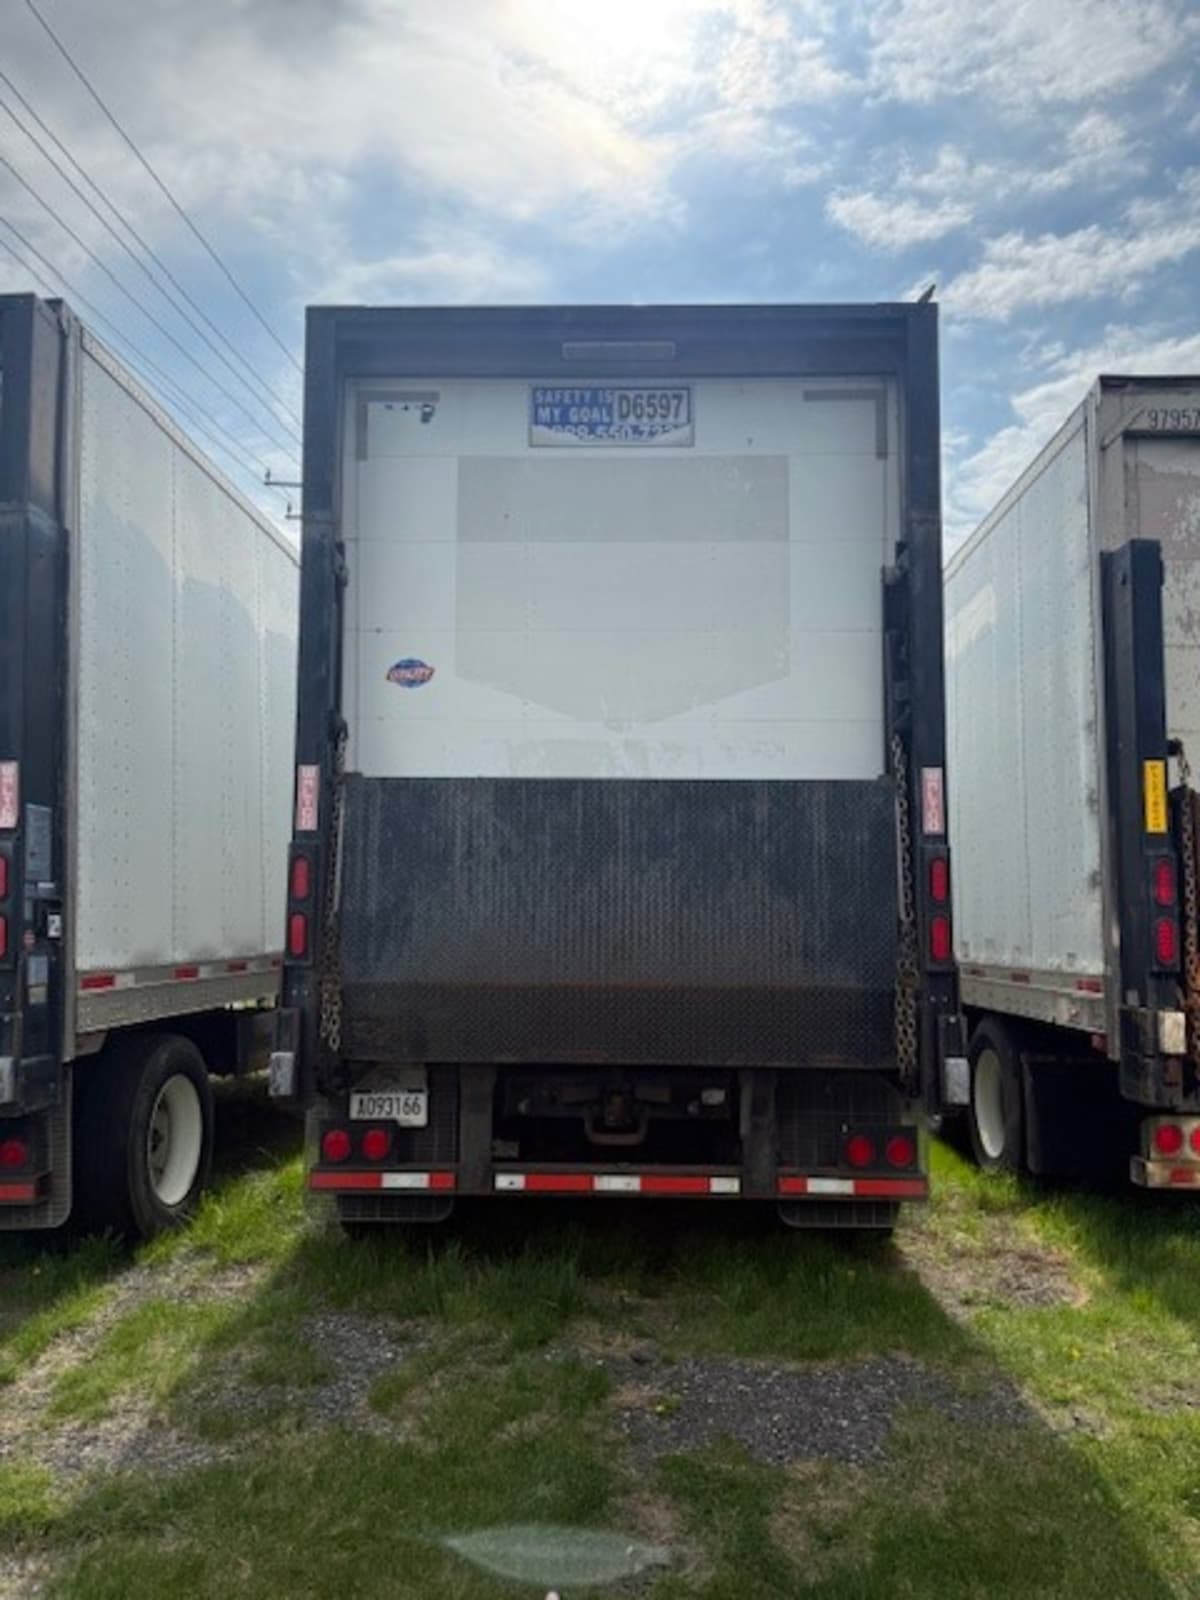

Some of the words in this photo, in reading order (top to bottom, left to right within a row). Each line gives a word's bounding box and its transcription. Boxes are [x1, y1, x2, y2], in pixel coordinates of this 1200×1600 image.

[535, 389, 592, 404] SAFETY
[599, 389, 615, 404] IS
[537, 406, 561, 423] MY
[569, 406, 611, 423] GOAL
[619, 393, 683, 420] D6597
